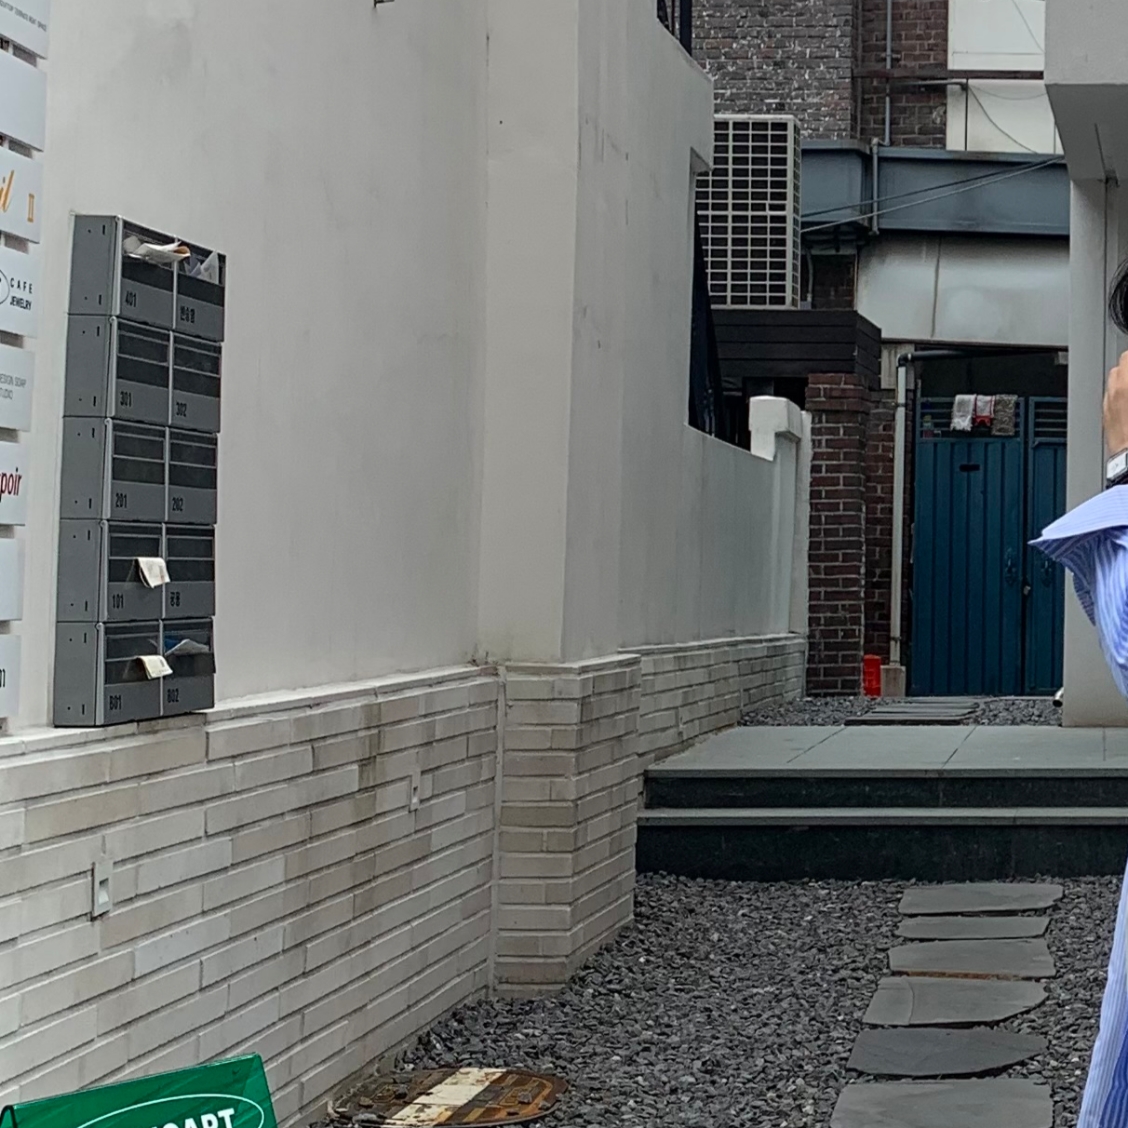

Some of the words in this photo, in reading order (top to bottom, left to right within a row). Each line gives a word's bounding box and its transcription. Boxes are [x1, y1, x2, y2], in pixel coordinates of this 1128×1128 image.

[10, 277, 33, 295] CAFE
[10, 295, 32, 311] JEWELRY
[125, 290, 137, 308] 401
[120, 391, 132, 408] 301
[176, 401, 187, 418] 302
[0, 466, 23, 503] poir
[115, 492, 128, 509] 201
[171, 496, 184, 512] 202
[112, 593, 124, 609] 101
